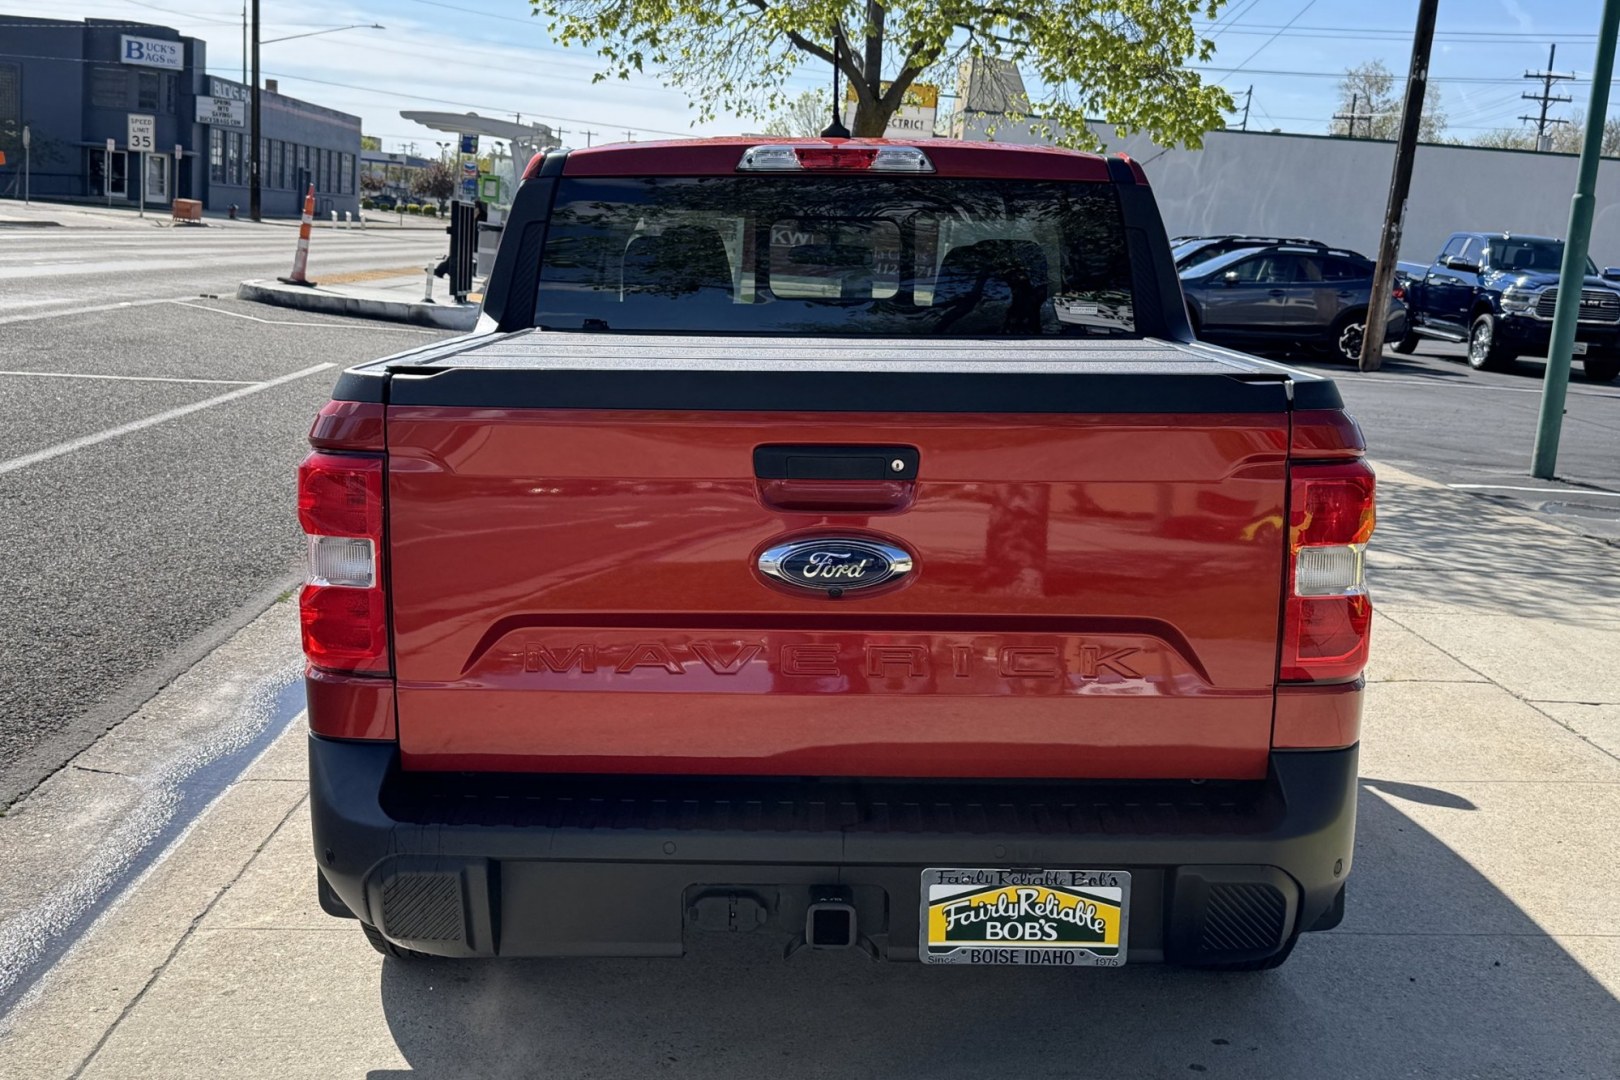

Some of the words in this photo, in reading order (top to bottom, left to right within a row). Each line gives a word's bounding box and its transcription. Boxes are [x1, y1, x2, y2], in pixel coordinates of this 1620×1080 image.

[125, 40, 176, 59] BUCK'S
[131, 117, 152, 126] SPEED
[132, 126, 149, 135] LIMIT
[131, 135, 151, 148] 35
[802, 551, 867, 578] Ford
[524, 641, 1151, 681] MAVERICK
[936, 870, 993, 886] Fairly
[997, 870, 1066, 886] Reliable
[1070, 870, 1118, 887] Bob's
[941, 893, 1018, 931] Fairly
[1016, 888, 1106, 934] Reliable
[985, 919, 1059, 942] BOB'S
[928, 955, 957, 965] Since
[970, 949, 1020, 965] BOISE
[1024, 949, 1074, 966] IDAHO
[1095, 957, 1118, 967] 1975
